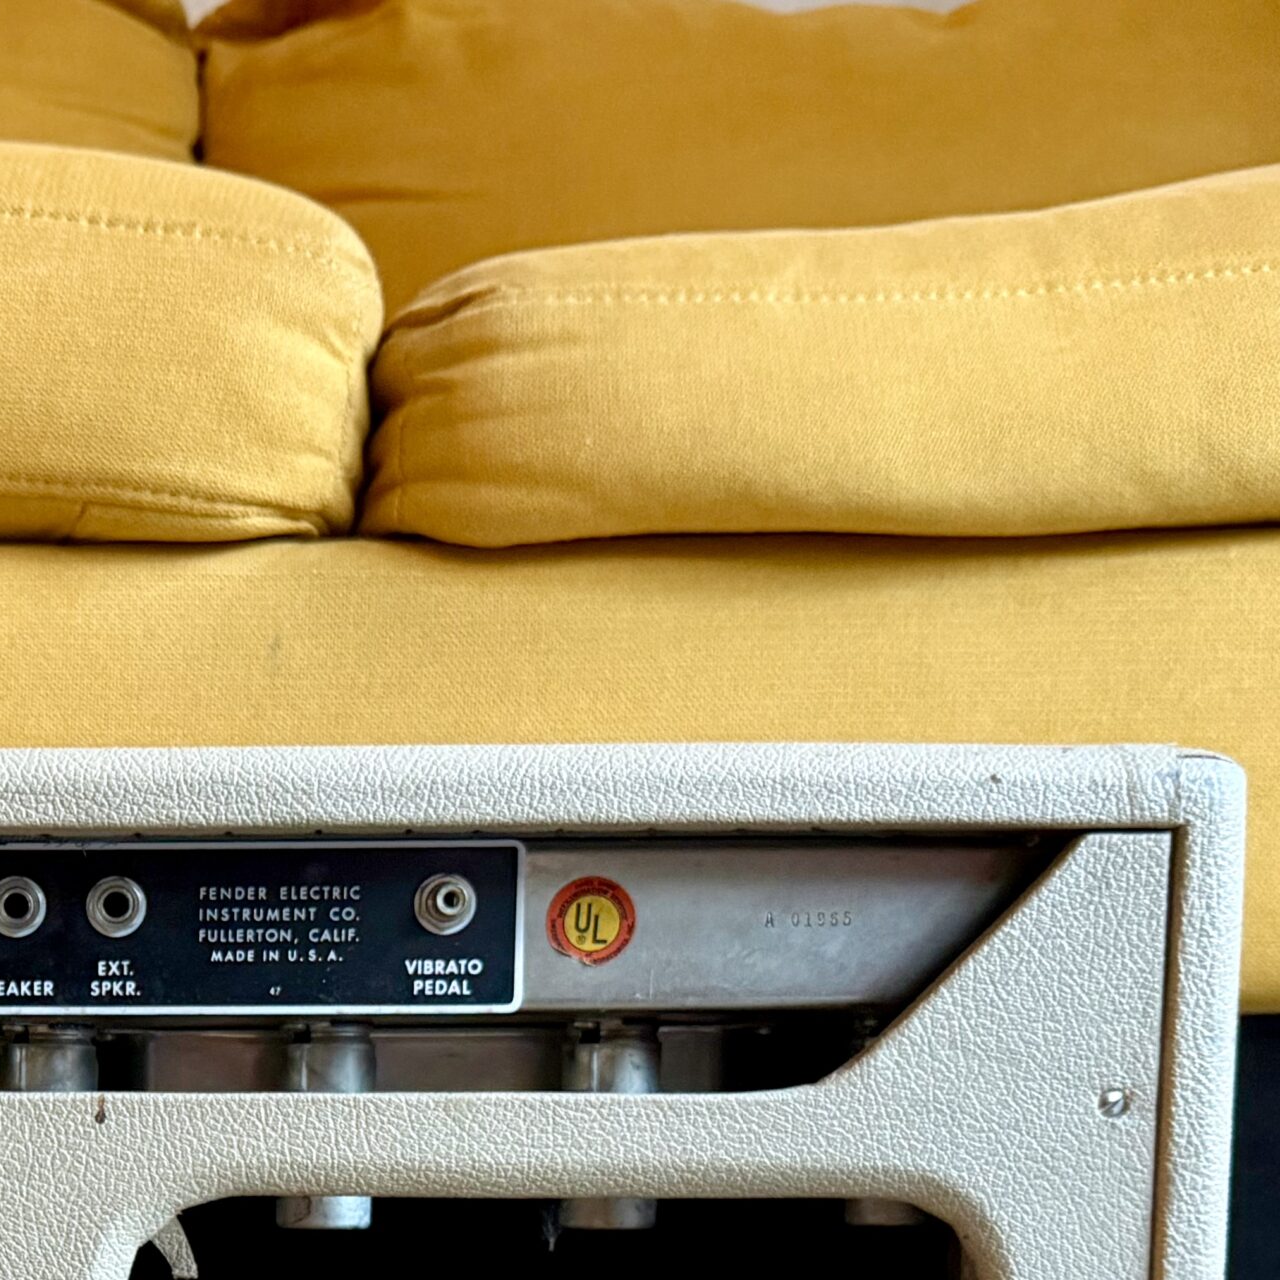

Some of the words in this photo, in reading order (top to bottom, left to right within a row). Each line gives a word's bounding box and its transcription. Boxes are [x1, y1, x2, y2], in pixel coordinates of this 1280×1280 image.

[199, 886, 267, 901] FENDER
[279, 885, 361, 901] ELECTRIC
[198, 906, 317, 922] INSTRUMENT
[329, 906, 360, 922] CO.
[763, 910, 776, 929] A
[574, 901, 609, 945] UL
[198, 928, 299, 945] FULLERTON,
[308, 927, 360, 943] CALIF.
[210, 949, 255, 963] MADE
[262, 949, 280, 962] IN
[97, 960, 134, 977] EXT.
[404, 958, 483, 975] VIBRATO
[90, 980, 141, 997] SPKR.
[413, 978, 472, 996] PEDAL
